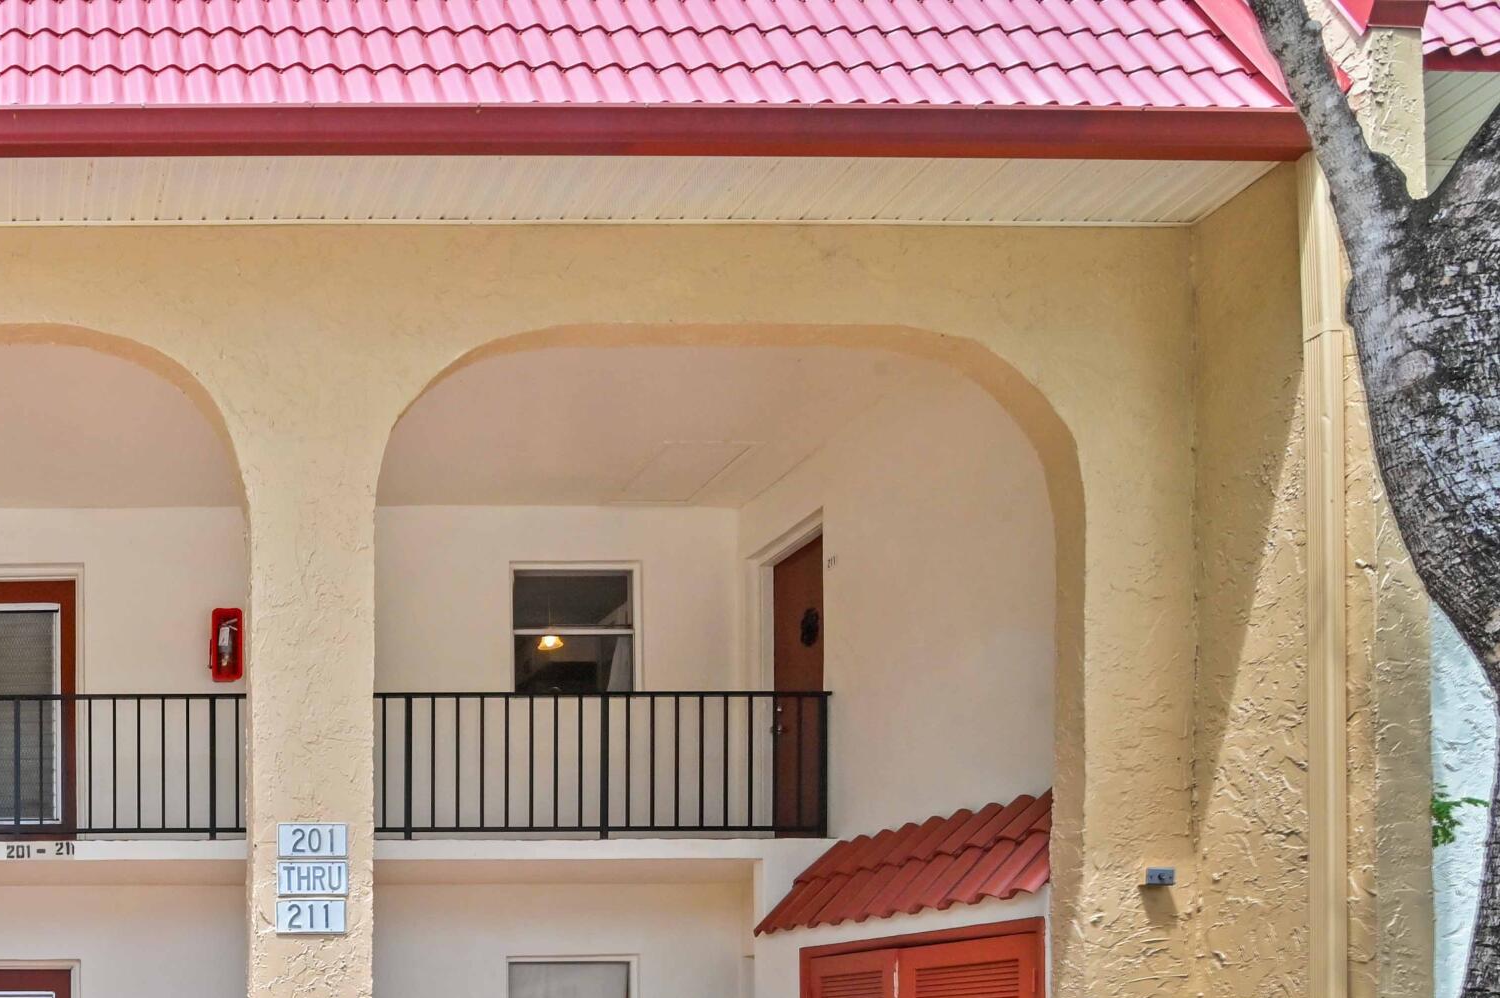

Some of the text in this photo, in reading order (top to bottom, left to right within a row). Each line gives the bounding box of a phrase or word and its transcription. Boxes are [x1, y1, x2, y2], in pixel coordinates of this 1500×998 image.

[6, 844, 31, 859] 201
[291, 828, 334, 853] 201
[282, 865, 342, 891] THRU
[287, 904, 329, 929] 211
